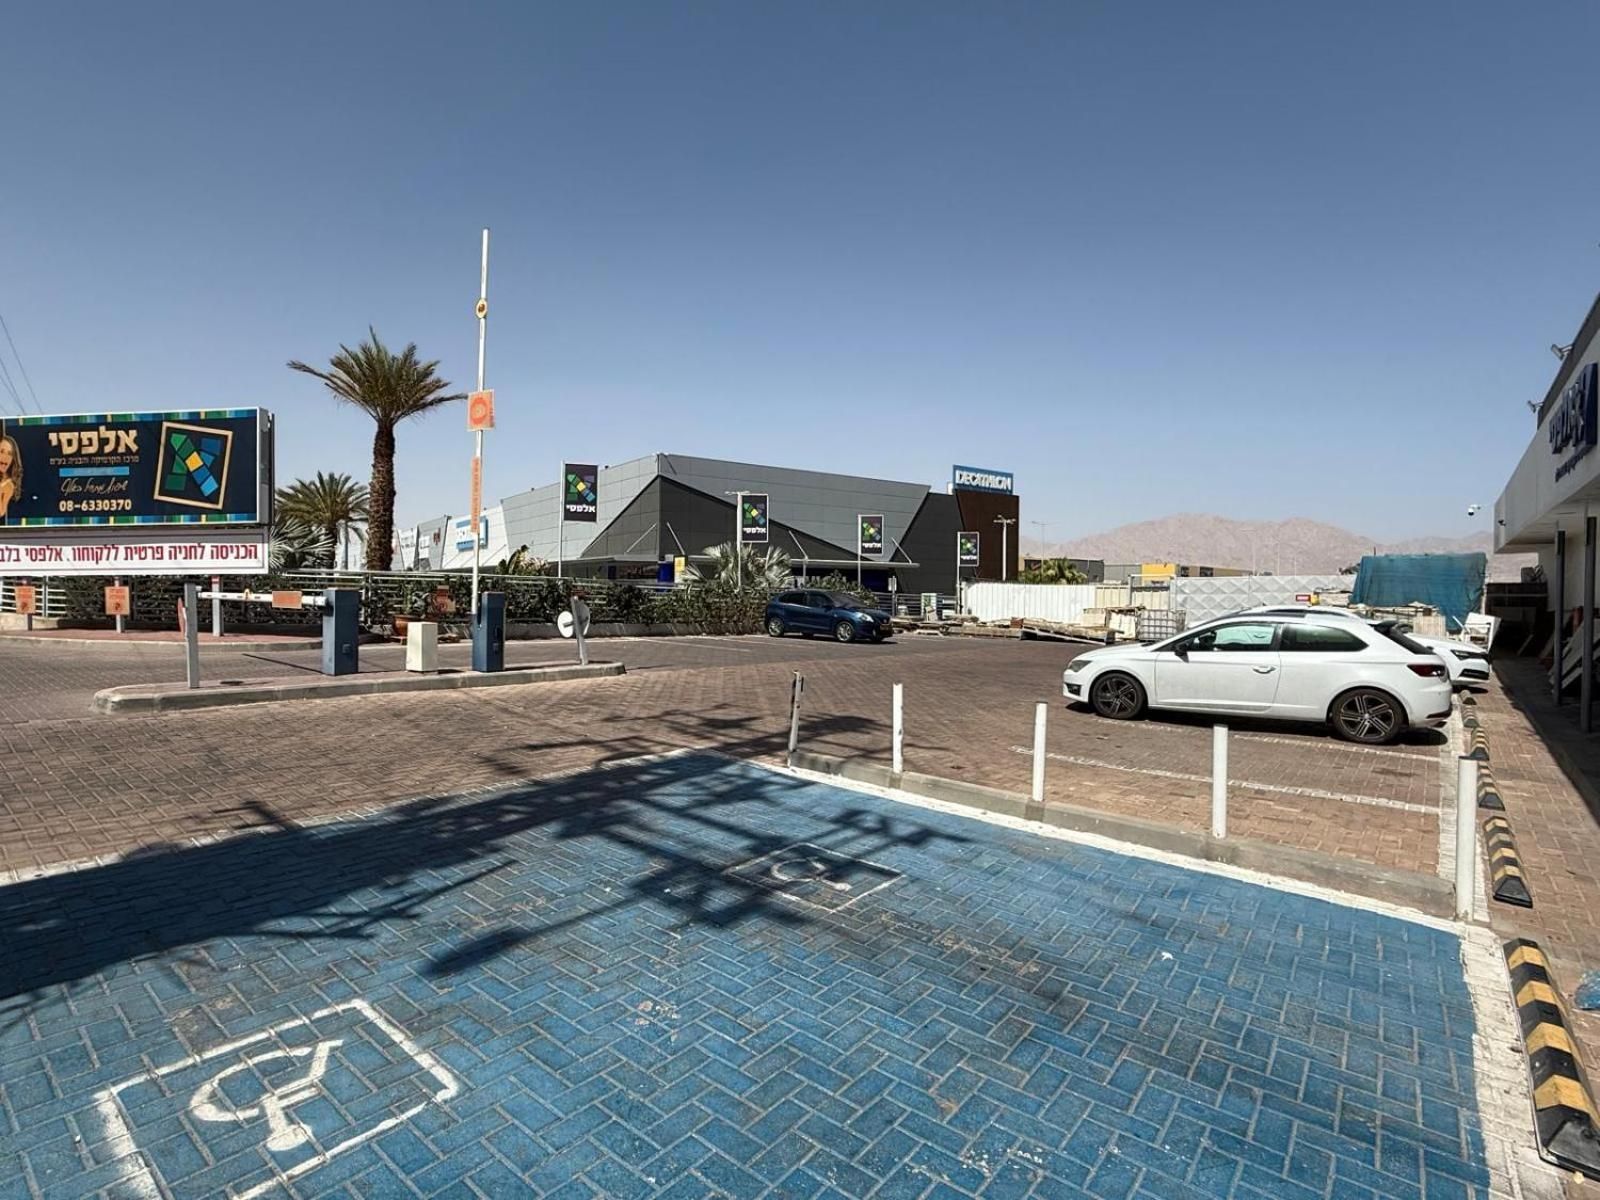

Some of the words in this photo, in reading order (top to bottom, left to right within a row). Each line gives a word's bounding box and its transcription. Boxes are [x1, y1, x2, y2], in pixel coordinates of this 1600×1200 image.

[48, 425, 139, 455] אלפסי
[955, 470, 1012, 490] DECATHLON
[59, 499, 132, 512] 08-6330370
[565, 504, 596, 513] אלפסי
[24, 545, 63, 562] אלפסי
[124, 545, 164, 560] פרטית
[168, 542, 206, 560] לחניה
[210, 544, 258, 559] הכניסה
